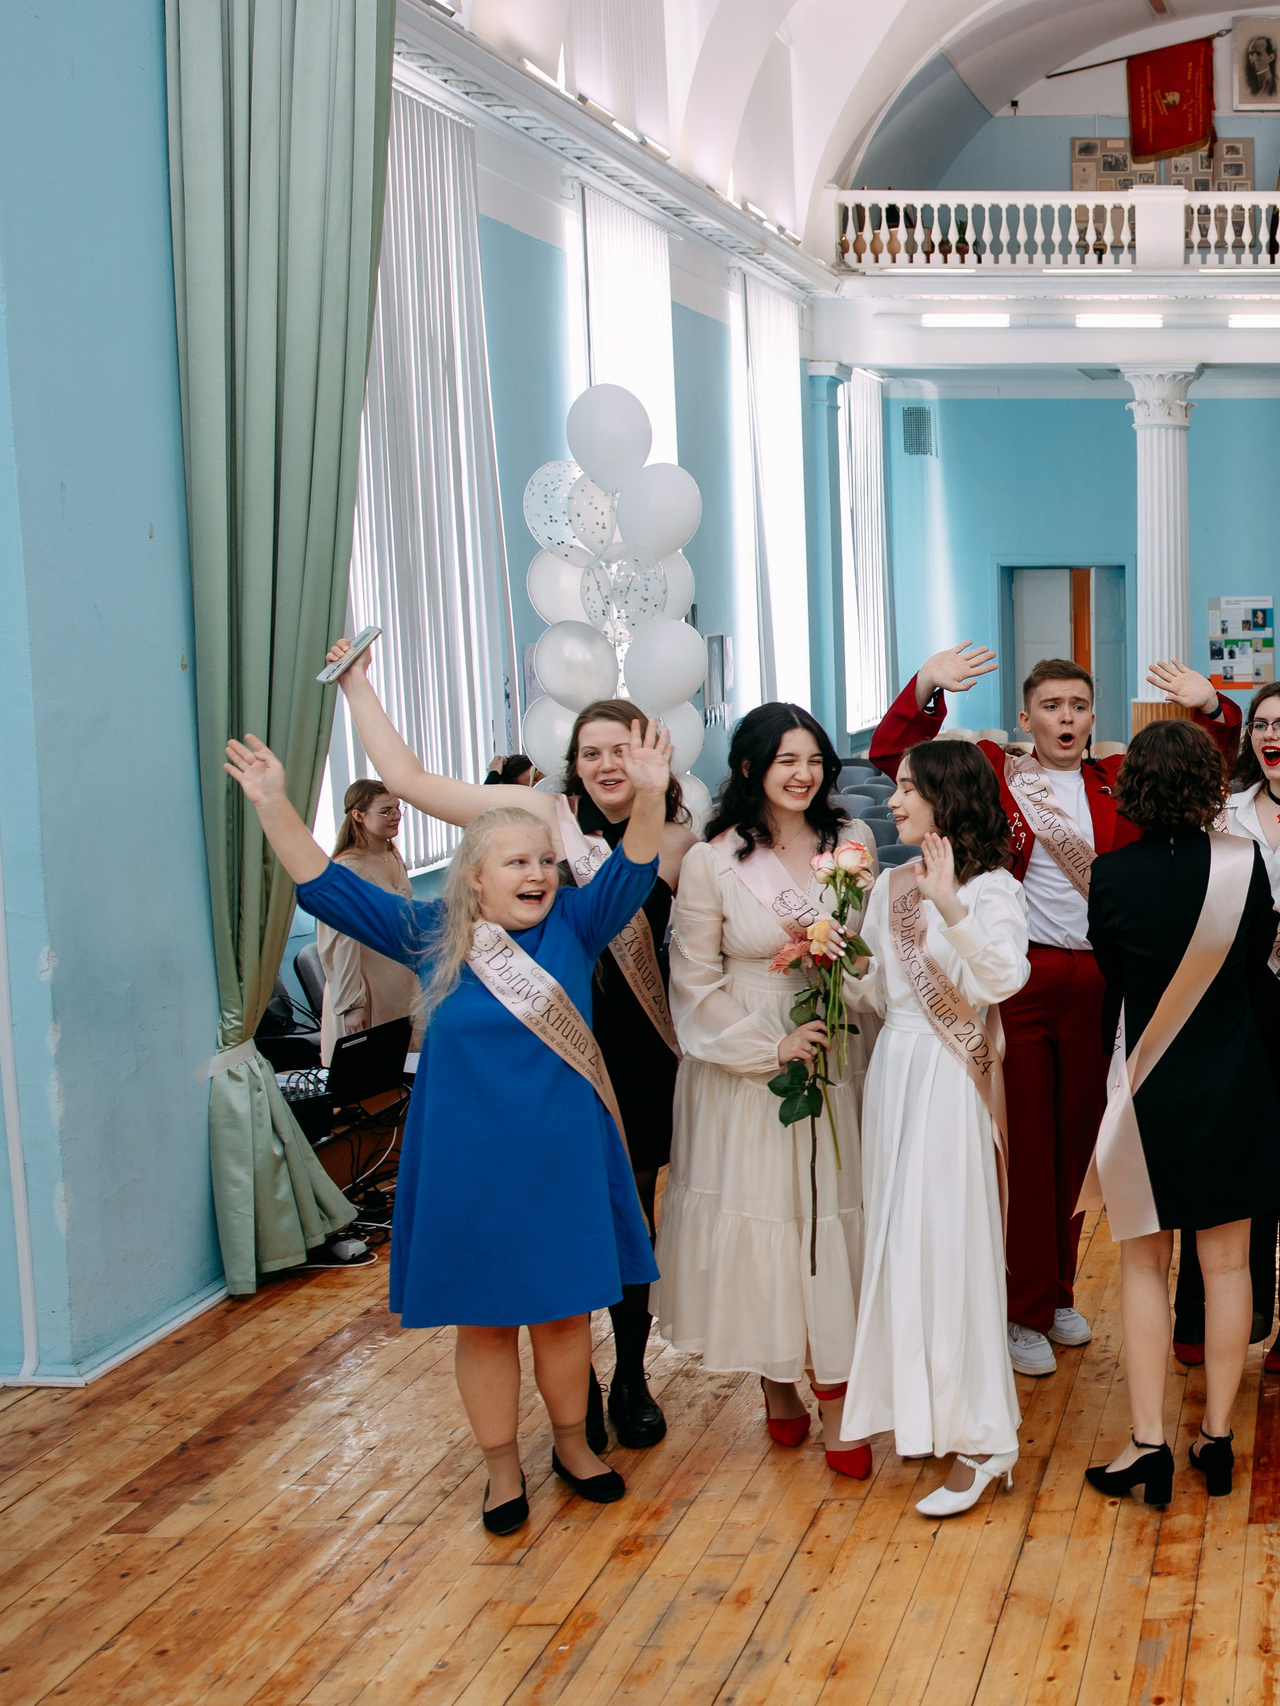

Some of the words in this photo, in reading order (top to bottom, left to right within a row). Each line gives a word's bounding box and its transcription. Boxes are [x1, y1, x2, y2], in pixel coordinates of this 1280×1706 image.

[1026, 788, 1090, 879] Выпускник
[485, 944, 589, 1057] Выпускница
[530, 966, 565, 1005] Сотникова
[900, 908, 959, 1030] Выпускница
[954, 1019, 996, 1076] 2024
[936, 974, 960, 1005] Софья
[555, 1040, 586, 1070] «Покровский
